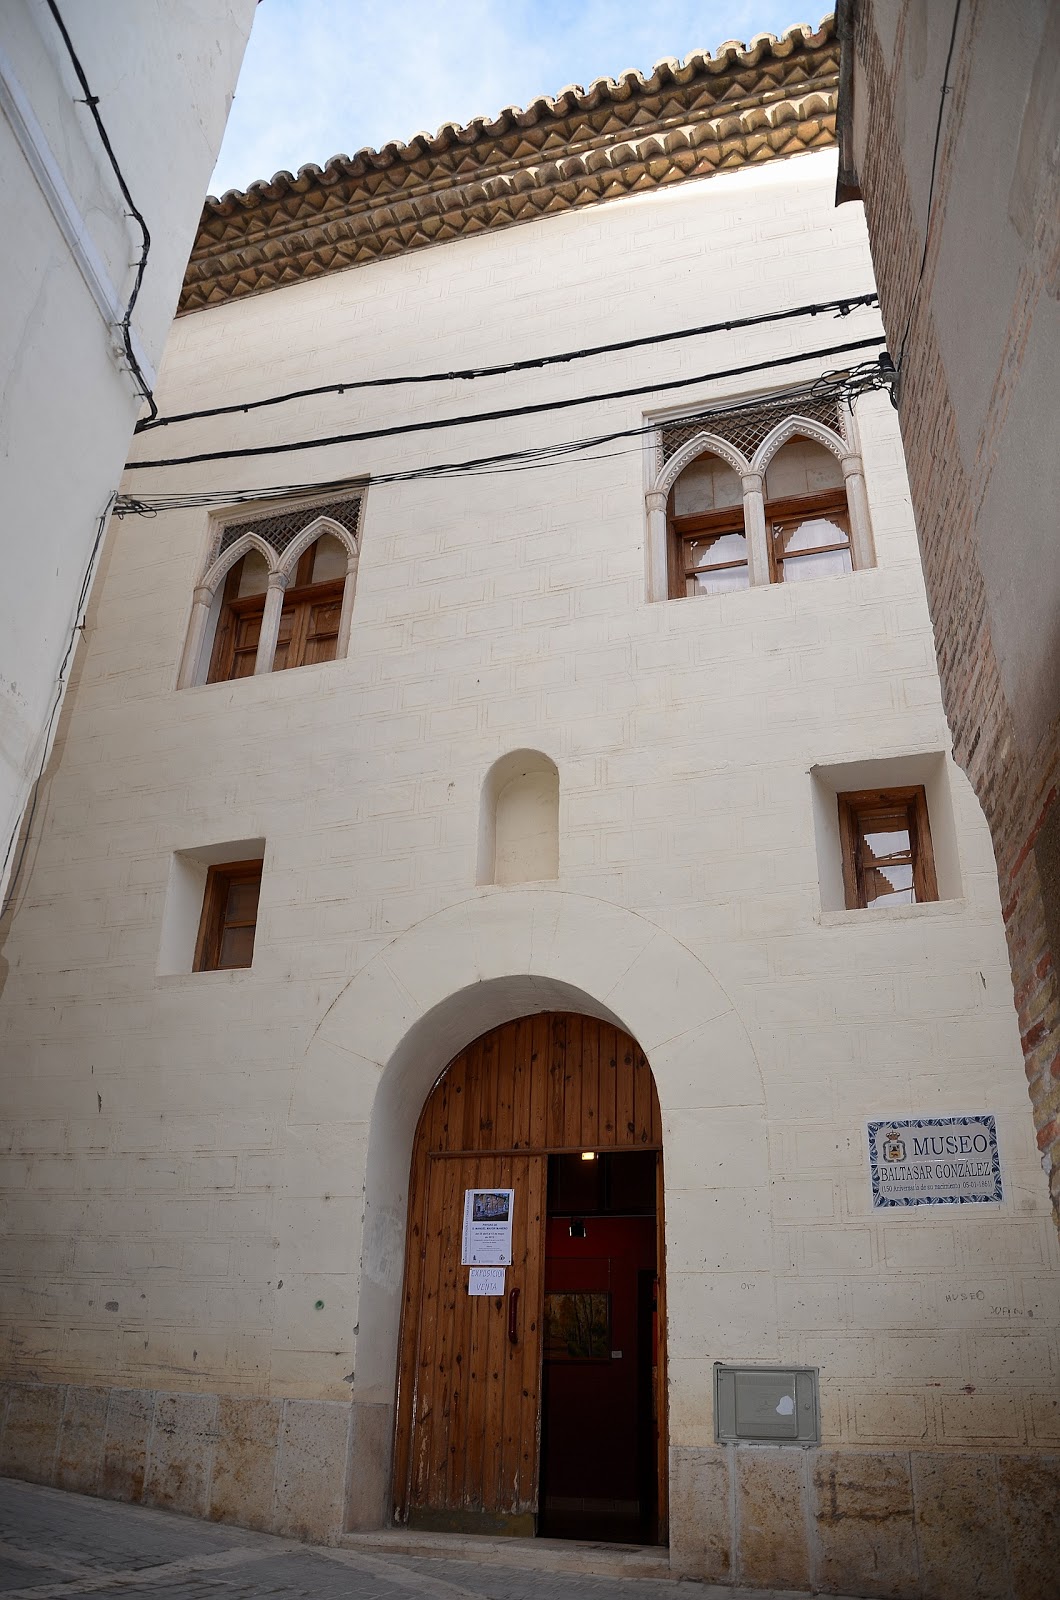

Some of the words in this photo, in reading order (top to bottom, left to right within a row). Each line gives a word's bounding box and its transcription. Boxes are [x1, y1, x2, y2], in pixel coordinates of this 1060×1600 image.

[913, 1134, 988, 1156] MUSEO
[881, 1165, 932, 1182] BALTASAR
[935, 1160, 991, 1179] GONZÁLEZ
[476, 1283, 497, 1291] VENTA
